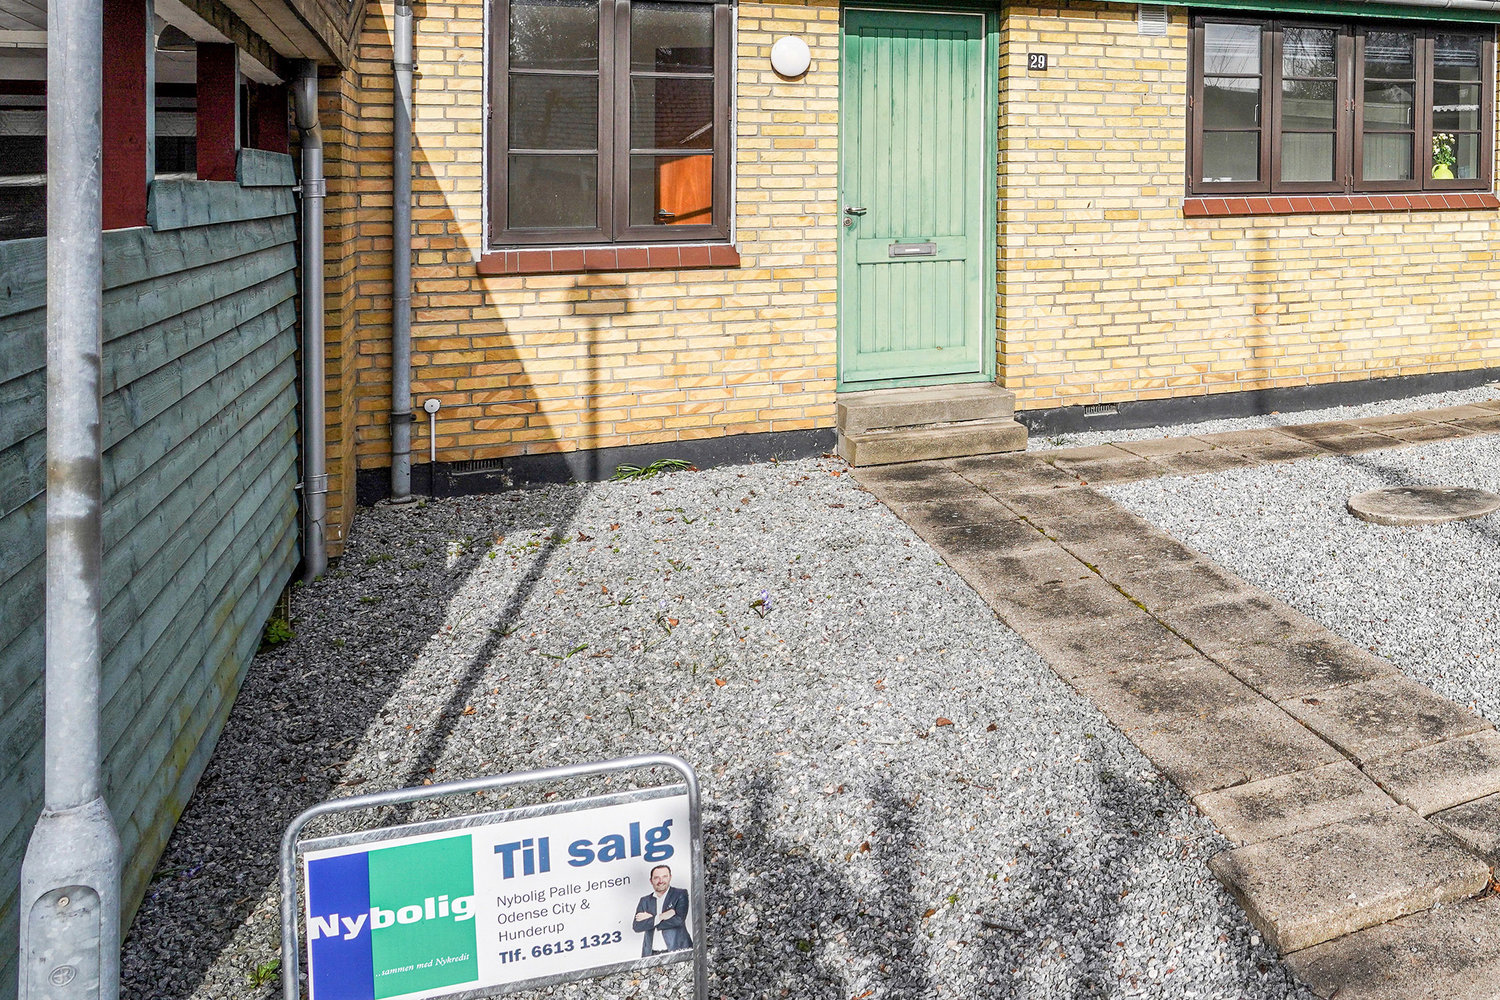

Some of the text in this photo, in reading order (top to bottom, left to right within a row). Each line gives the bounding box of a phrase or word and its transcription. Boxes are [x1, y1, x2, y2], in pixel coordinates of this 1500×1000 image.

[1031, 55, 1045, 68] 29
[494, 819, 674, 880] Til salg
[497, 875, 631, 908] Nybolig Palle Jensen
[310, 894, 476, 941] Nybolig
[497, 898, 591, 925] Odense City &
[498, 922, 565, 942] Hunderup
[416, 959, 433, 969] med
[434, 952, 470, 966] Nykredit
[499, 931, 623, 965] Tlf. 6613 1323
